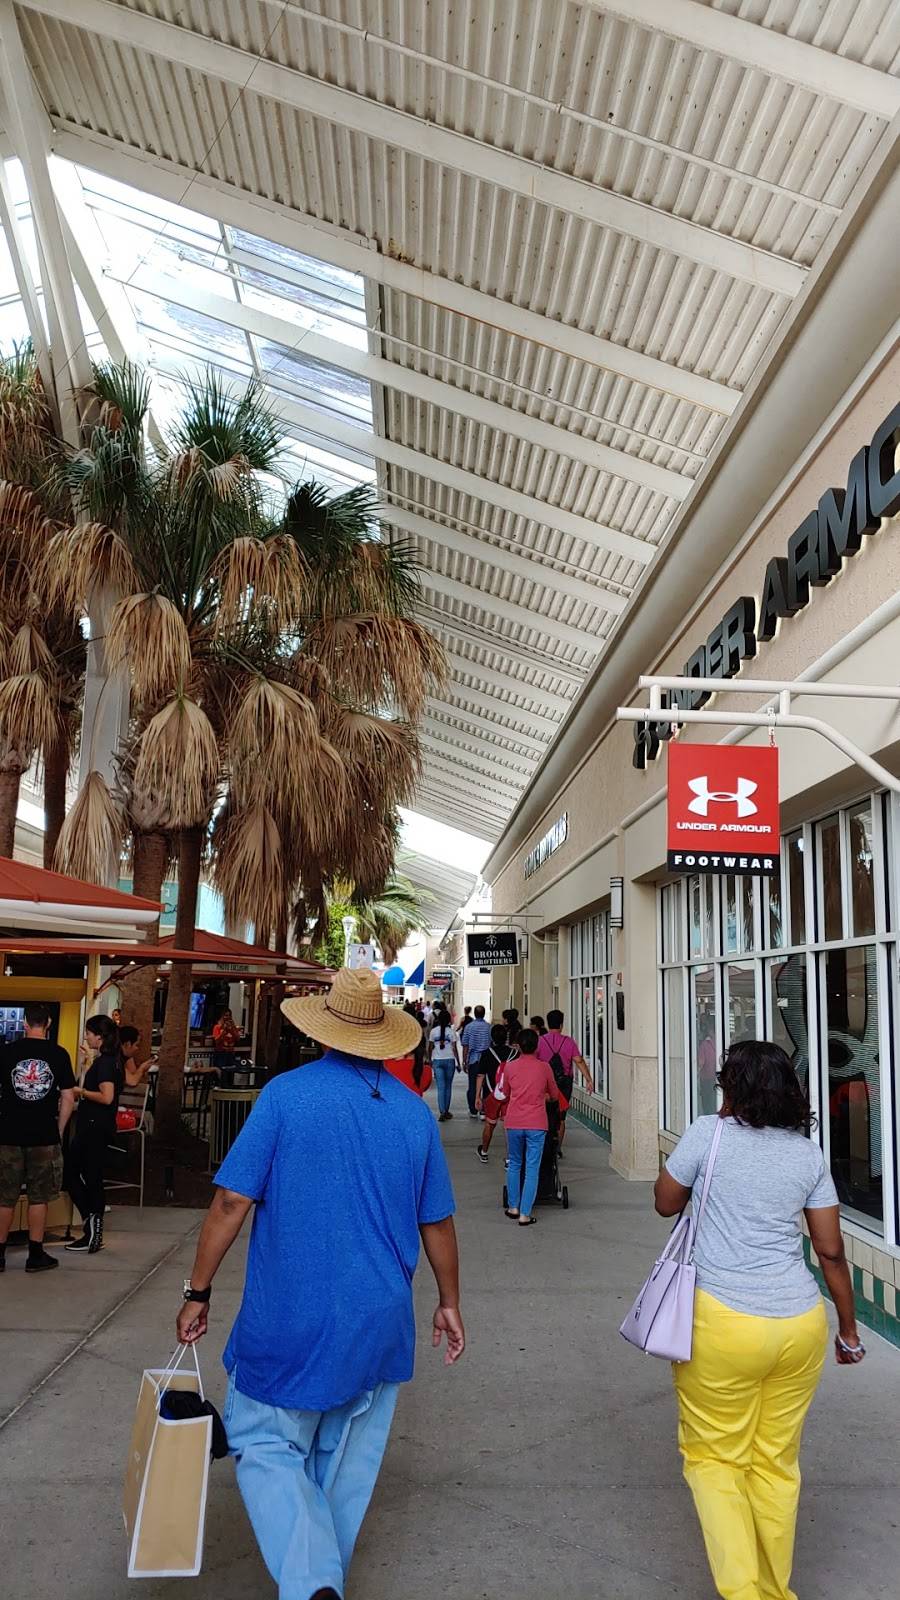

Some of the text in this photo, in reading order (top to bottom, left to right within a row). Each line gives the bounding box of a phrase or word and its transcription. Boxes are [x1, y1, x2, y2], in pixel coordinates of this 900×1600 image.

[676, 821, 771, 833] UNDER ARMOUR
[674, 855, 774, 869] FOOTWEAR
[473, 949, 513, 959] BROOKS
[474, 957, 514, 966] BROTHERS
